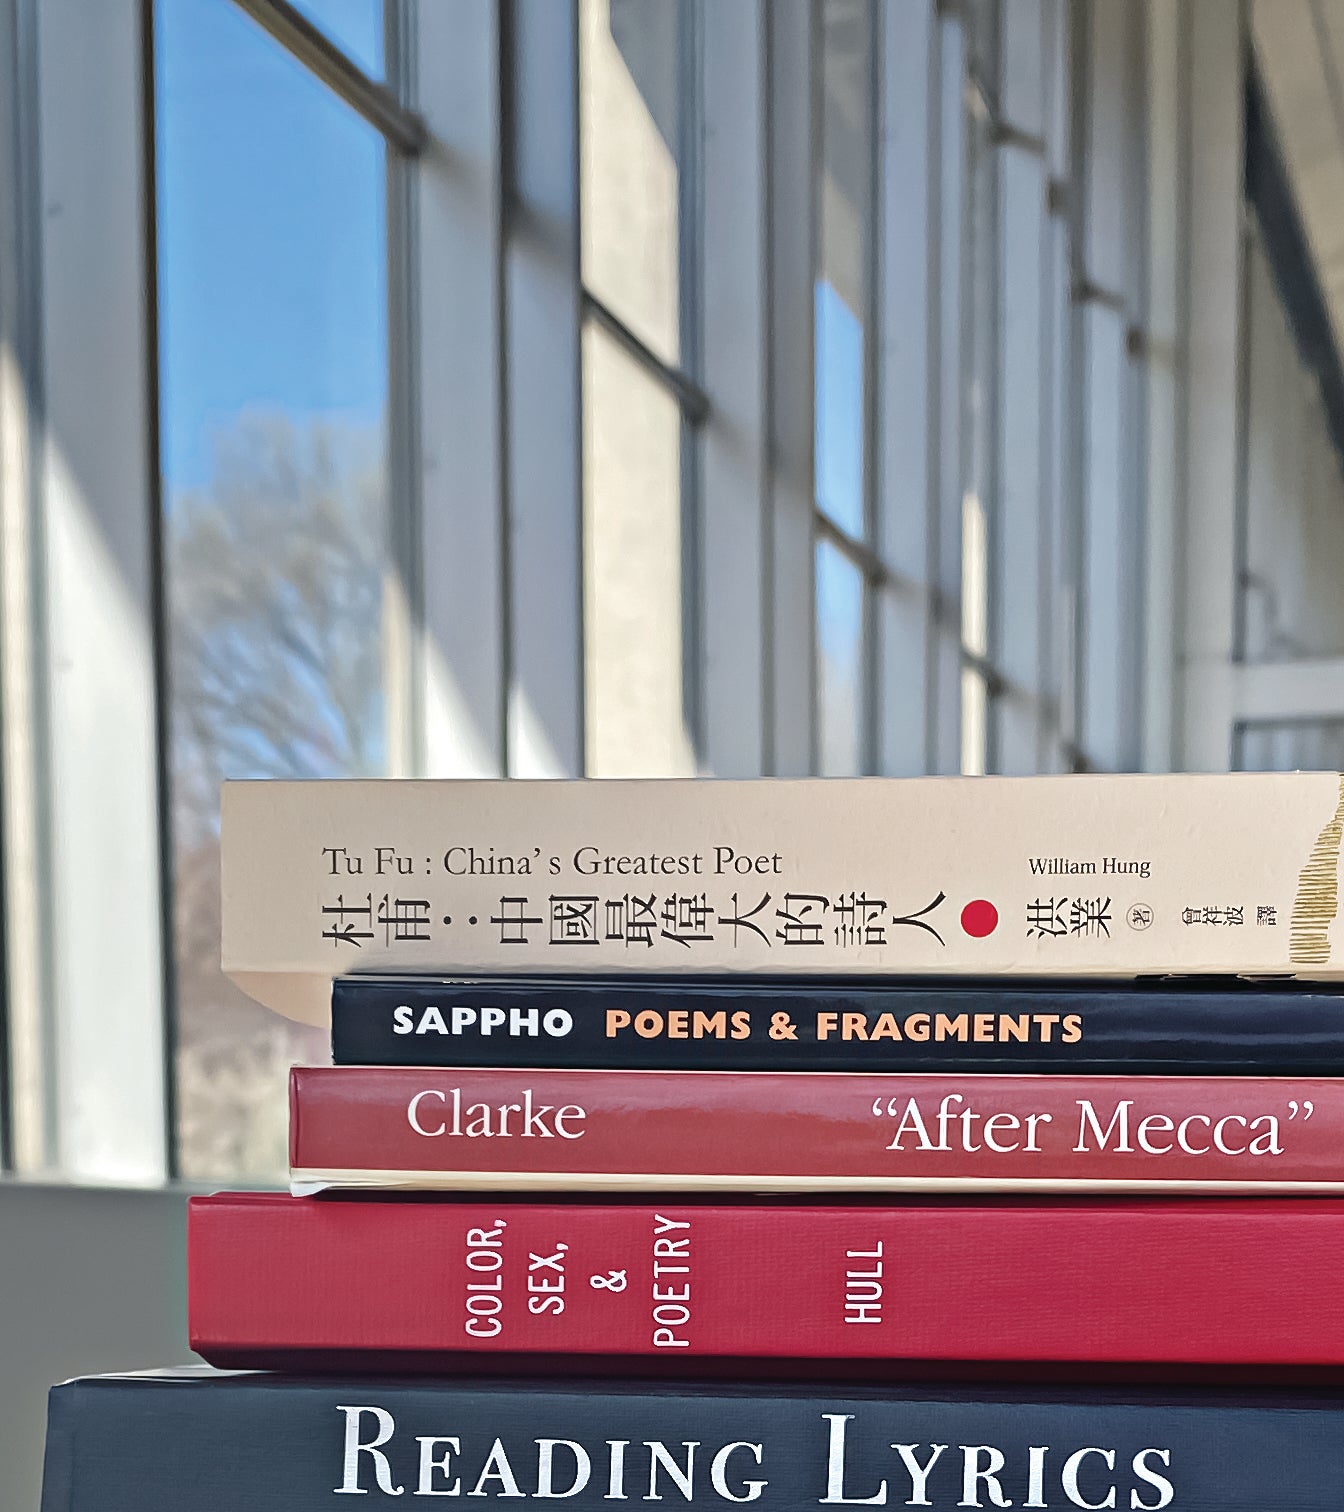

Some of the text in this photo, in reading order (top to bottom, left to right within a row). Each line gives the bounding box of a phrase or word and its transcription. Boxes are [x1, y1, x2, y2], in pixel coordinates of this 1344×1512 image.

[320, 846, 365, 876] Tu
[374, 847, 415, 875] Fu
[573, 846, 703, 875] Greatest
[713, 846, 783, 875] Poet
[1028, 857, 1151, 879] William Hung
[1026, 896, 1113, 940] 洪業
[393, 1005, 1082, 1043] SAPPHO POEMS & FRAGMENTS
[407, 1087, 1314, 1155] Clarke “After Mecca”
[465, 1219, 507, 1338] COLOR,
[527, 1242, 569, 1315] SEX,
[589, 1269, 627, 1293] &
[652, 1213, 691, 1347] POETRY
[844, 1240, 883, 1323] HULL
[333, 1405, 1174, 1511] READING LYRICS
